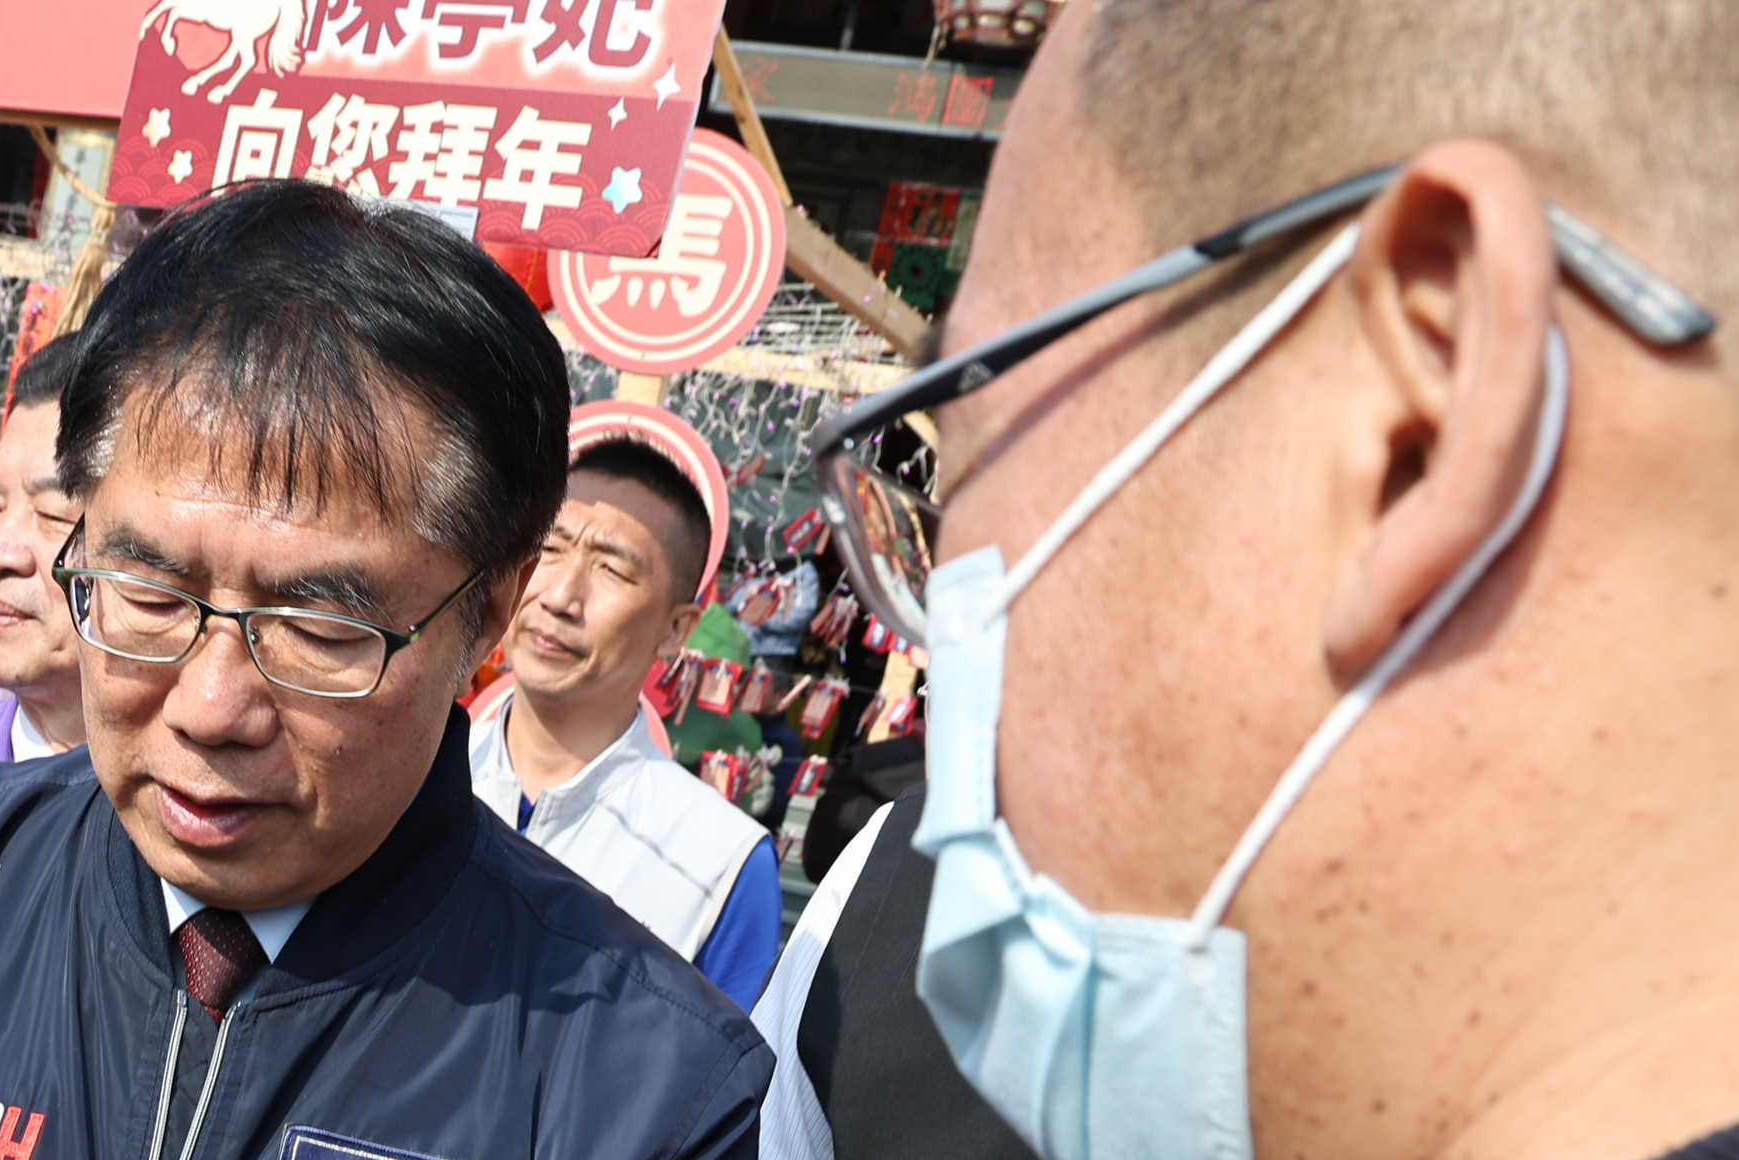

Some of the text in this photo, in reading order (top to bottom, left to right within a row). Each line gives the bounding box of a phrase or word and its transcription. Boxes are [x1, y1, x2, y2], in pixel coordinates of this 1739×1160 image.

[210, 88, 593, 231] 向您拜年
[590, 193, 734, 318] 馬
